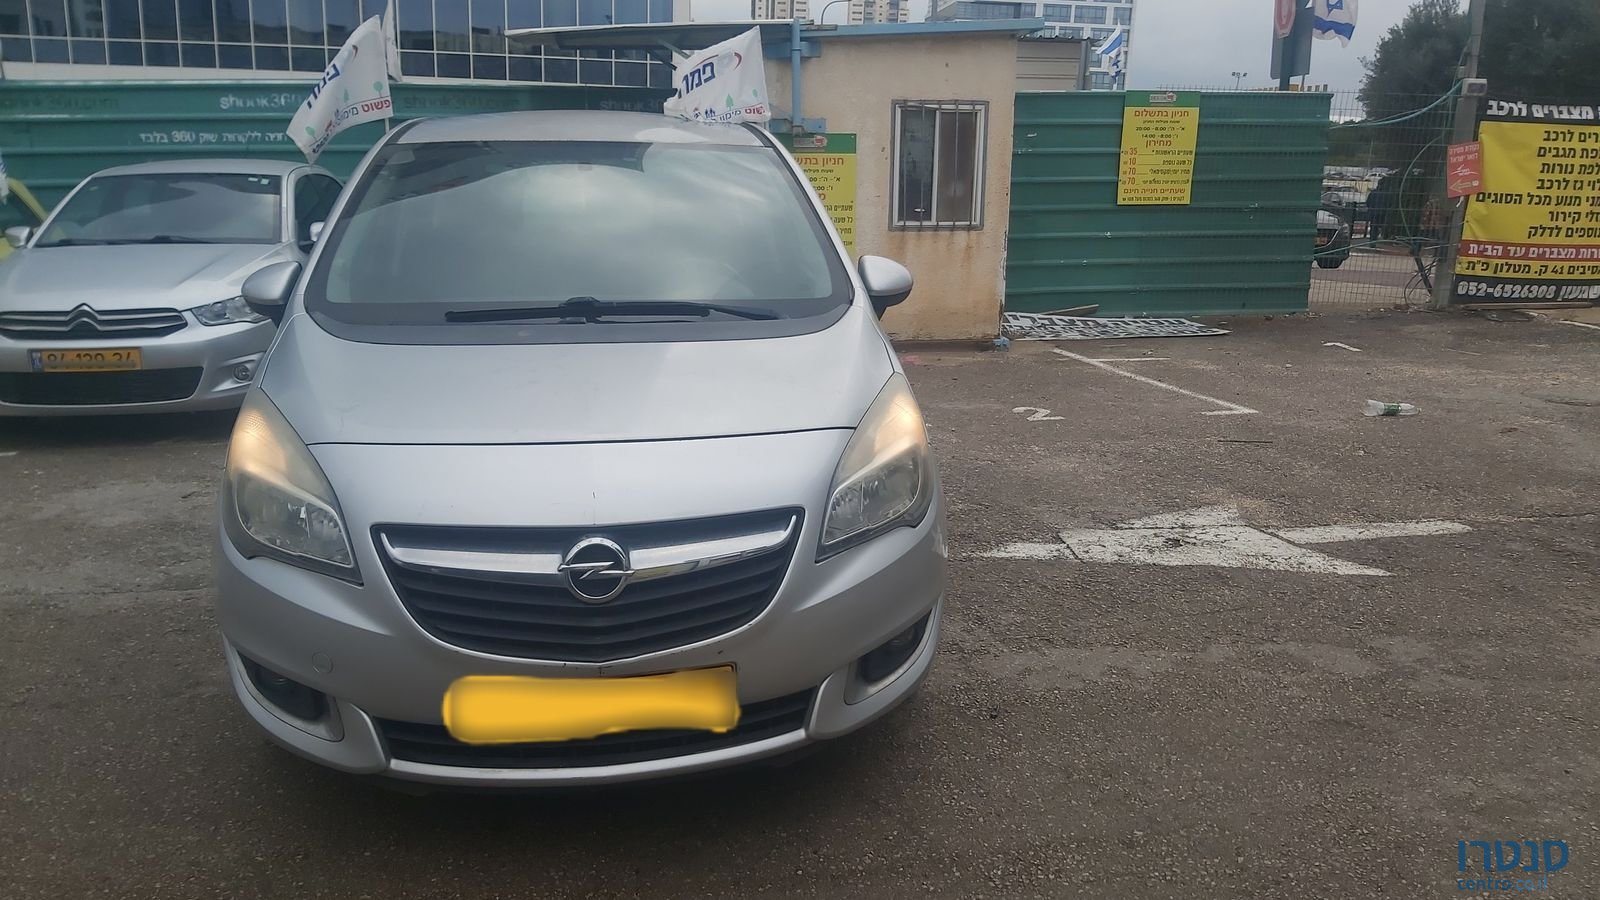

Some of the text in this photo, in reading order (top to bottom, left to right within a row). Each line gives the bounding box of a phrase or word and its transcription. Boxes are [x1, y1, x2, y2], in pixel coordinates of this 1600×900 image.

[361, 99, 391, 113] פשוט
[1486, 99, 1528, 117] לרכב
[1531, 104, 1595, 120] מצברים
[1134, 109, 1189, 118] חניון בתשלום
[139, 131, 169, 143] בלבד
[171, 130, 196, 143] 360
[199, 132, 219, 144] שוק
[1543, 129, 1575, 142] לרכב
[1145, 140, 1172, 149] מחירון
[1129, 148, 1138, 156] 35
[1537, 146, 1577, 159] מגבים
[822, 157, 844, 167] חניון
[1540, 162, 1575, 174] נורות
[1127, 177, 1136, 185] 70
[1536, 178, 1570, 190] לרכב
[1573, 179, 1584, 191] גז
[1475, 191, 1523, 205] הסוגים
[1527, 192, 1552, 206] מכל
[1555, 195, 1582, 207] מנוע
[1548, 211, 1581, 224] קירור
[1528, 224, 1562, 239] לדלק
[1468, 243, 1503, 256] הבית
[1507, 246, 1526, 257] עד
[1528, 247, 1577, 259] מצברים
[1465, 260, 1490, 272] פ"ת
[1493, 261, 1531, 275] מטלון
[1551, 265, 1563, 275] 41
[1457, 280, 1600, 301] שמעון 052-6526308
[1011, 406, 1065, 422] 2
